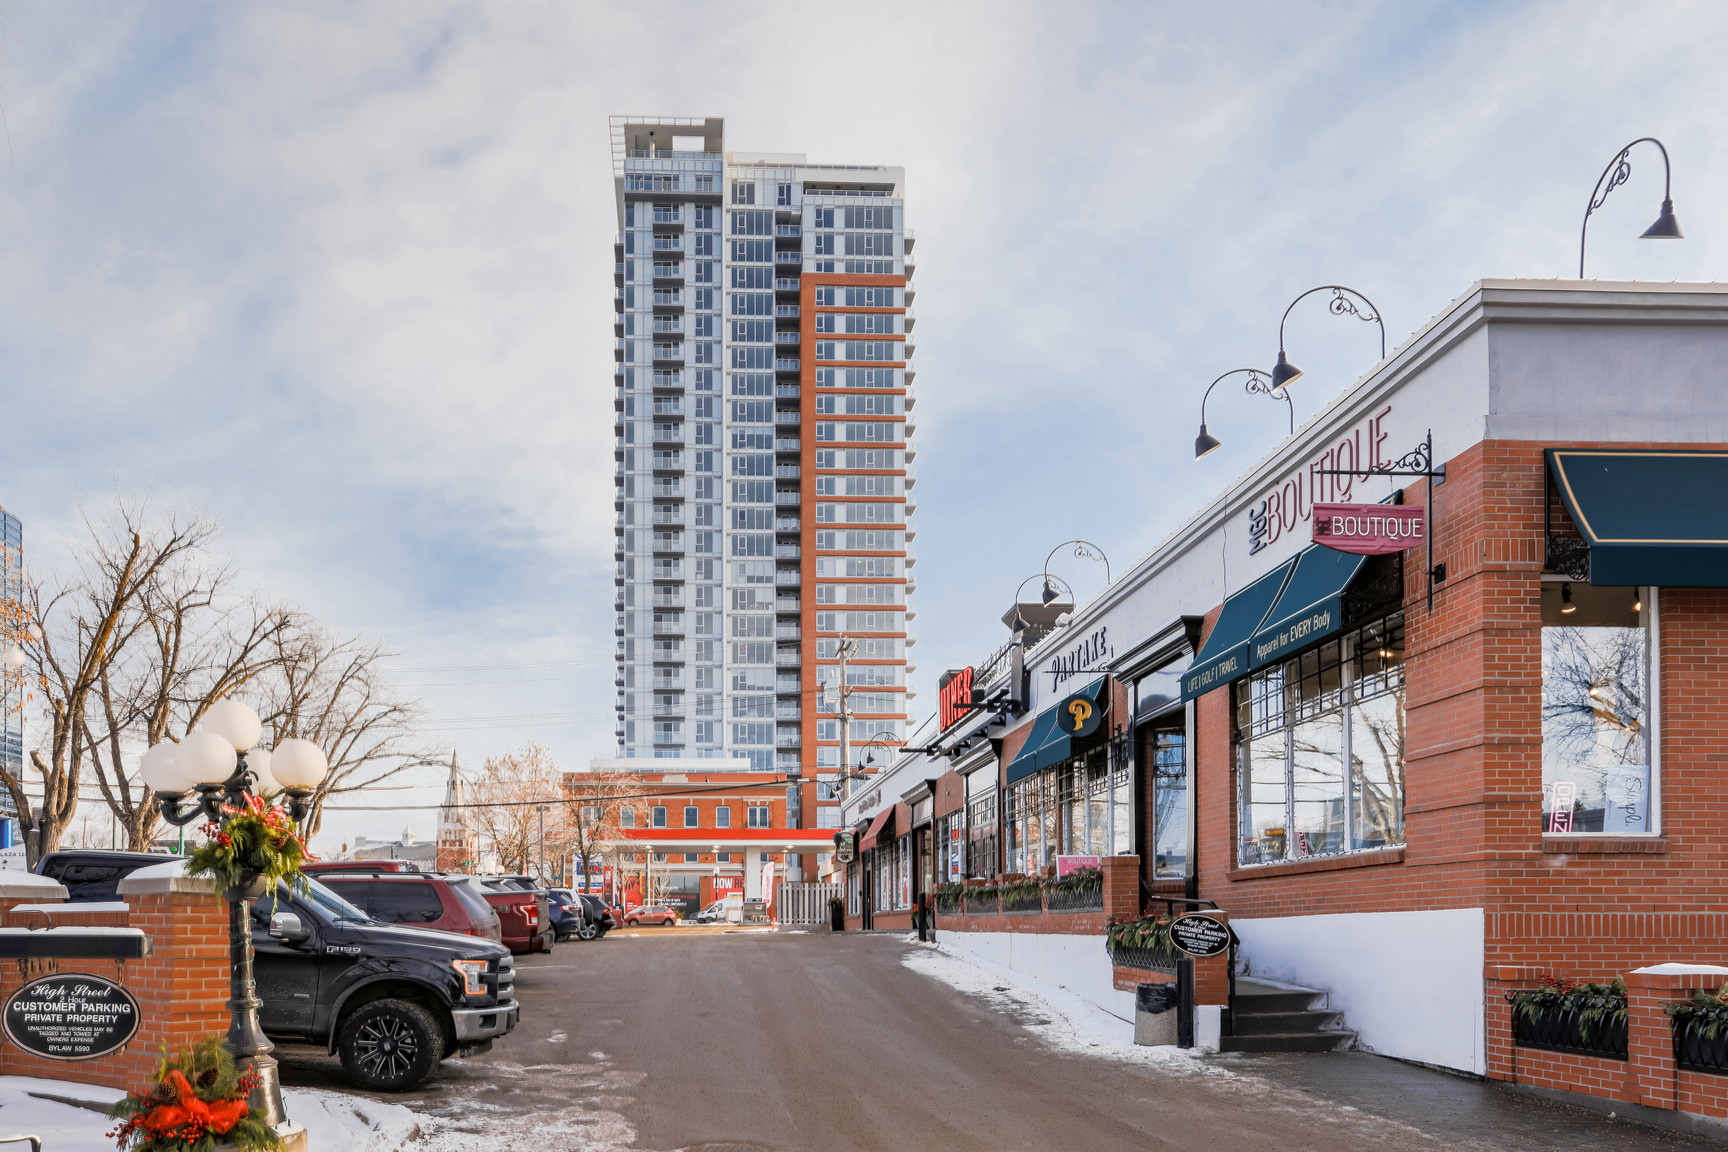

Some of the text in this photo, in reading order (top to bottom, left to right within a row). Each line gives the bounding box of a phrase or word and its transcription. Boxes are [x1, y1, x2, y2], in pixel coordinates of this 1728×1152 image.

[1267, 405, 1392, 545] BOUTIQUE
[1332, 516, 1423, 540] BOUTIQUE
[1256, 610, 1331, 661] Apparel for EVERY Body
[1052, 626, 1107, 693] PARTAKE
[1187, 677, 1199, 693] LIFE
[1201, 667, 1215, 686] GOLF
[1218, 656, 1239, 676] TRAVEL
[940, 666, 972, 732] DINER
[1068, 699, 1092, 731] P
[1553, 784, 1572, 832] OPEN
[713, 878, 733, 889] NOW
[1174, 925, 1202, 933] CUSTOMER
[1204, 929, 1227, 938] PARKING
[31, 984, 111, 999] High Street
[13, 1001, 131, 1013] CUSTOMER PARKING
[24, 1013, 118, 1023] PRIVATE PROPERTY
[48, 1044, 72, 1052] BYLAW
